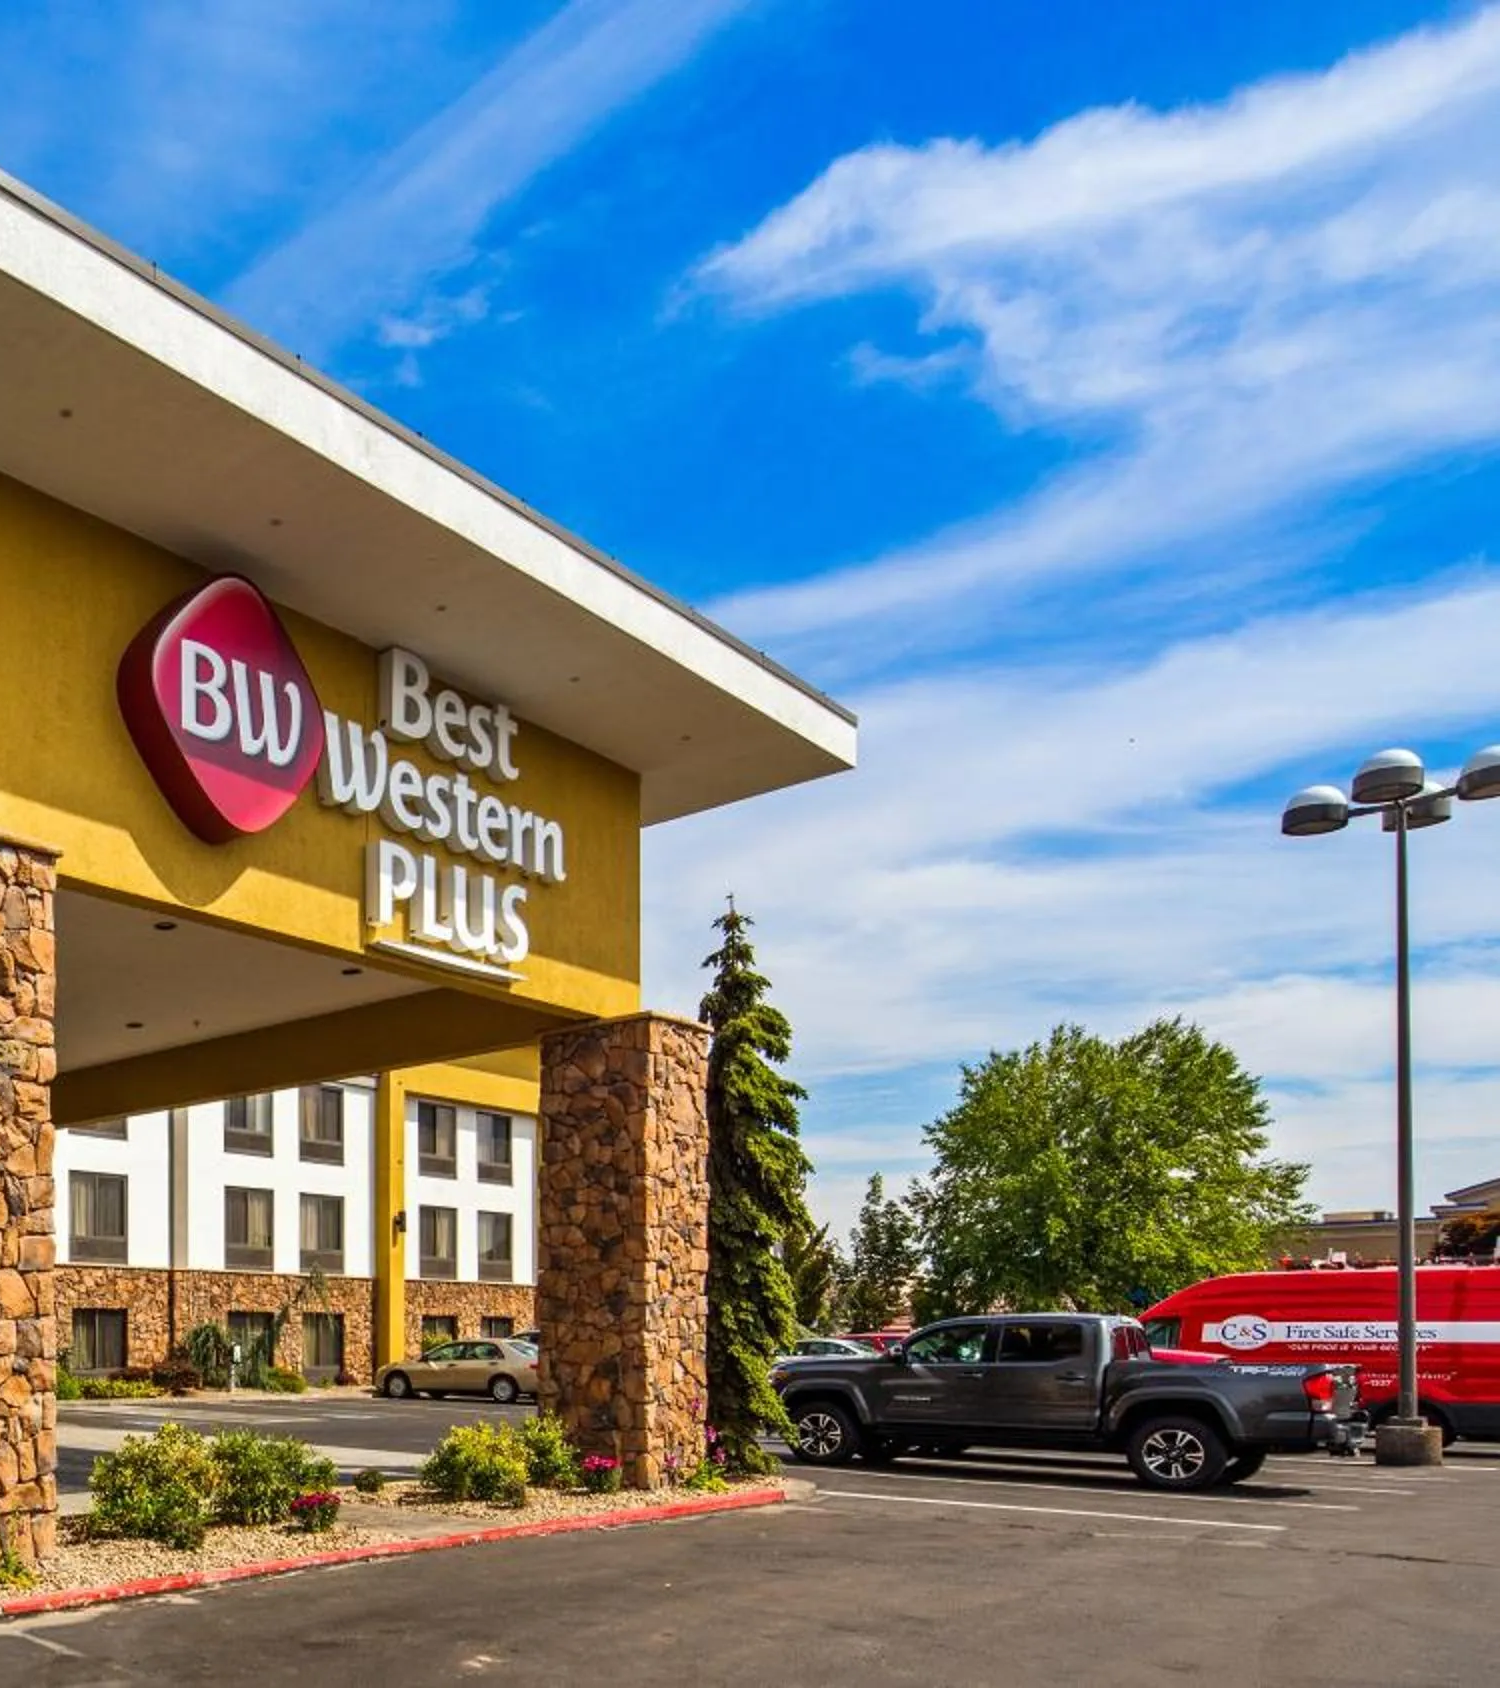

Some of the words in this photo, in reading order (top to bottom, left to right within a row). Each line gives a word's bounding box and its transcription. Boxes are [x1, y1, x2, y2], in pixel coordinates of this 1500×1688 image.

[180, 638, 302, 767] BW
[382, 646, 520, 781] Best
[322, 709, 567, 881] Western
[373, 839, 530, 963] PLUS
[1285, 1325, 1321, 1339] Fire
[1323, 1325, 1361, 1339] Safe
